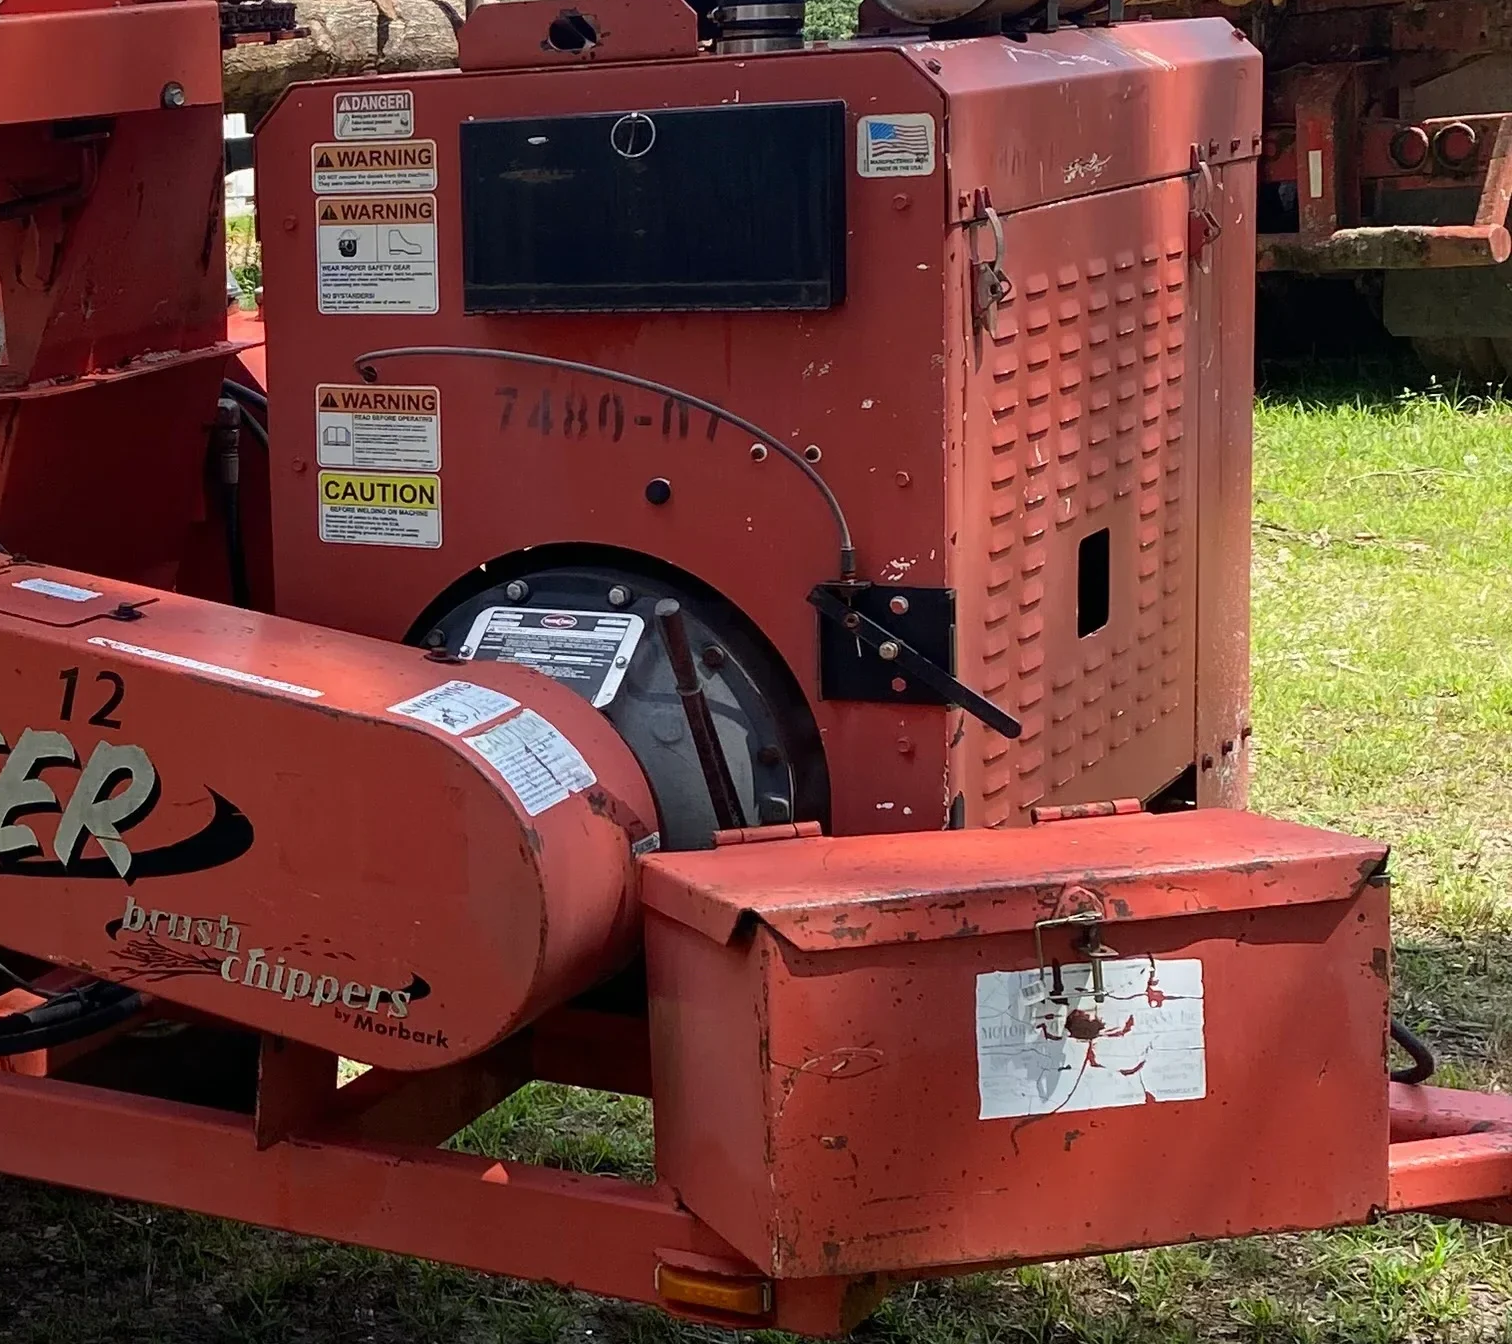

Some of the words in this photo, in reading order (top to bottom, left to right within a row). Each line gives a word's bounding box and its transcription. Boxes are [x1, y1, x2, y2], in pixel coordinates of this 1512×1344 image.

[352, 95, 408, 111] DANGER!
[337, 149, 431, 167] WARNING
[341, 203, 432, 220] WARNING
[341, 393, 435, 411] WARNING
[325, 480, 434, 504] CAUTION
[58, 666, 127, 730] 12
[413, 681, 473, 712] WARNING
[474, 715, 544, 755] CAUTION
[121, 895, 242, 954] brush
[220, 947, 412, 1019] chippers
[334, 1007, 351, 1024] by
[353, 1013, 449, 1050] Morbark
